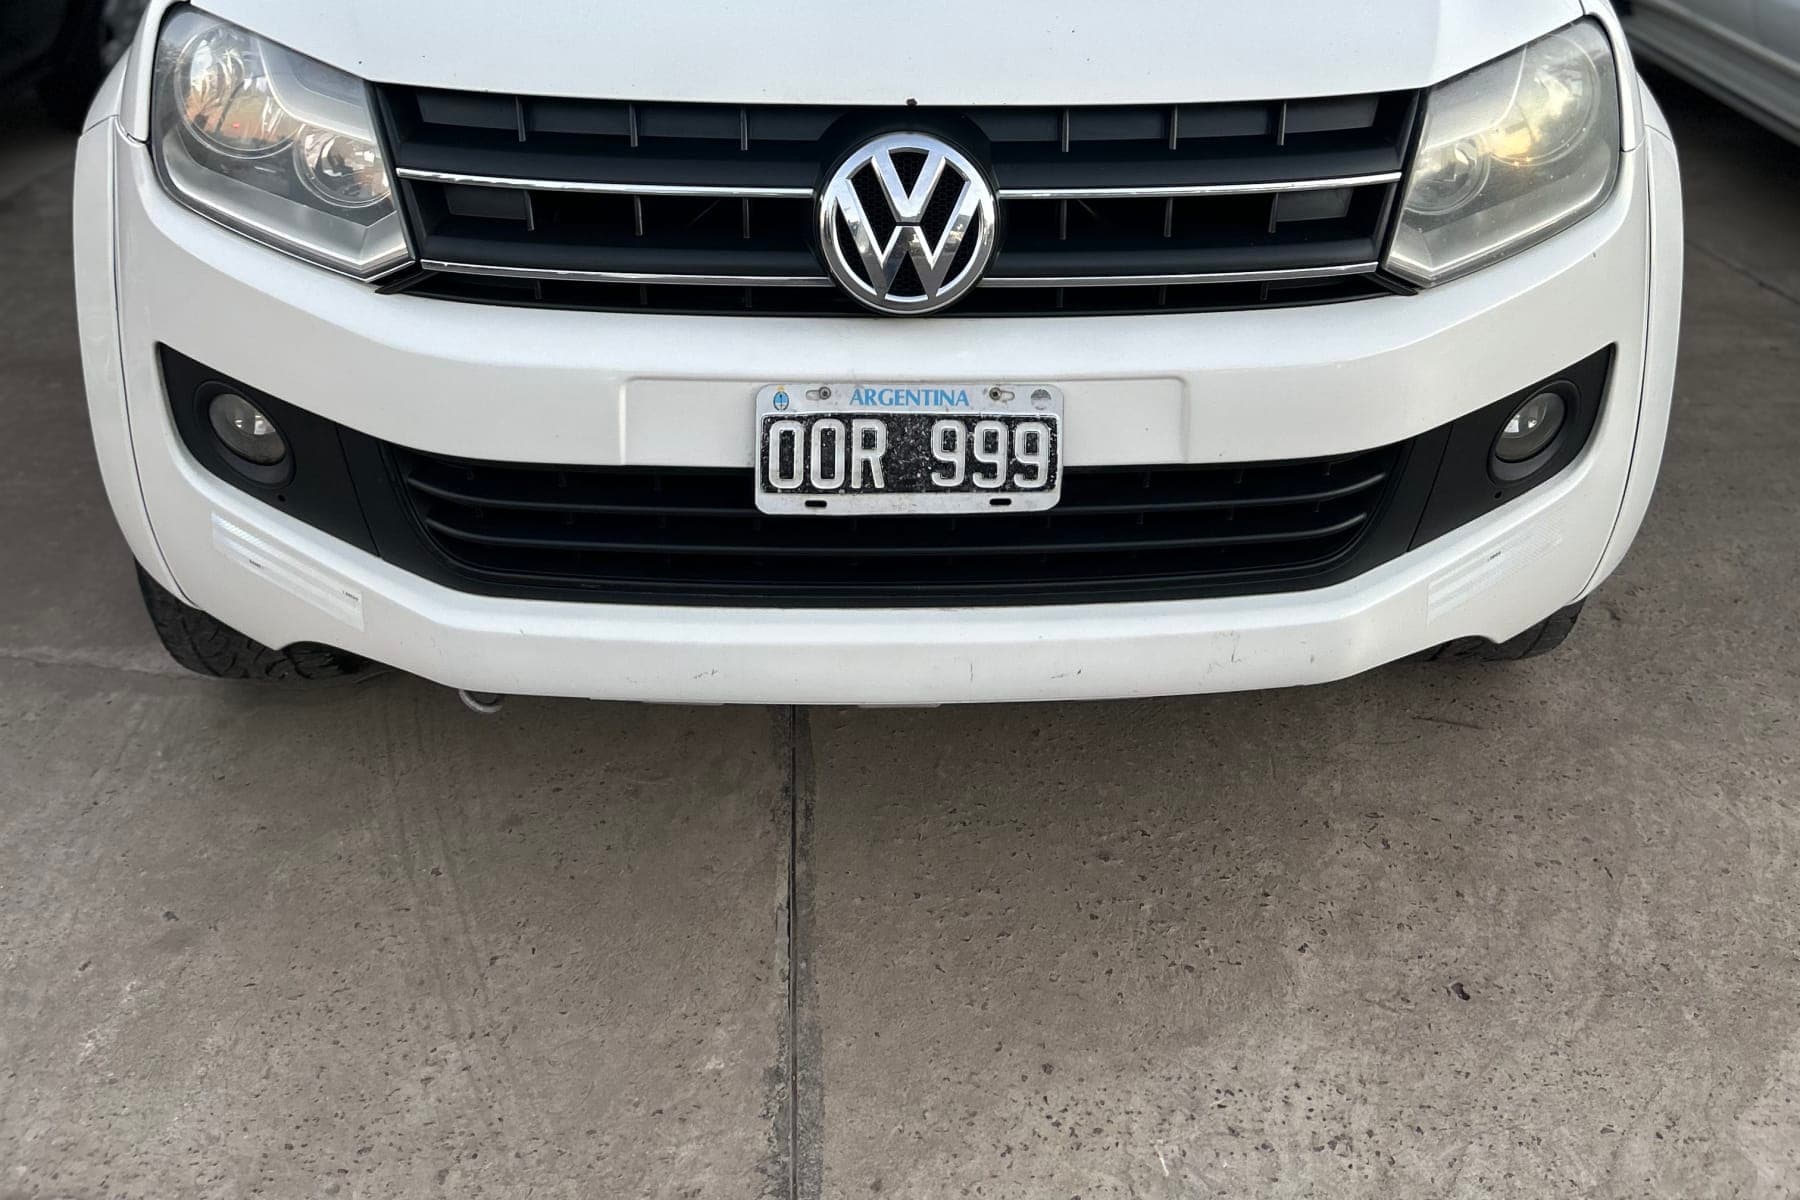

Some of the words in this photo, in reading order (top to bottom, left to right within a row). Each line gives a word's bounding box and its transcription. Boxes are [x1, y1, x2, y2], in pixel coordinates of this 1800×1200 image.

[849, 388, 970, 407] ARGENTINA
[768, 418, 888, 490] OOR
[931, 418, 1050, 490] 999
